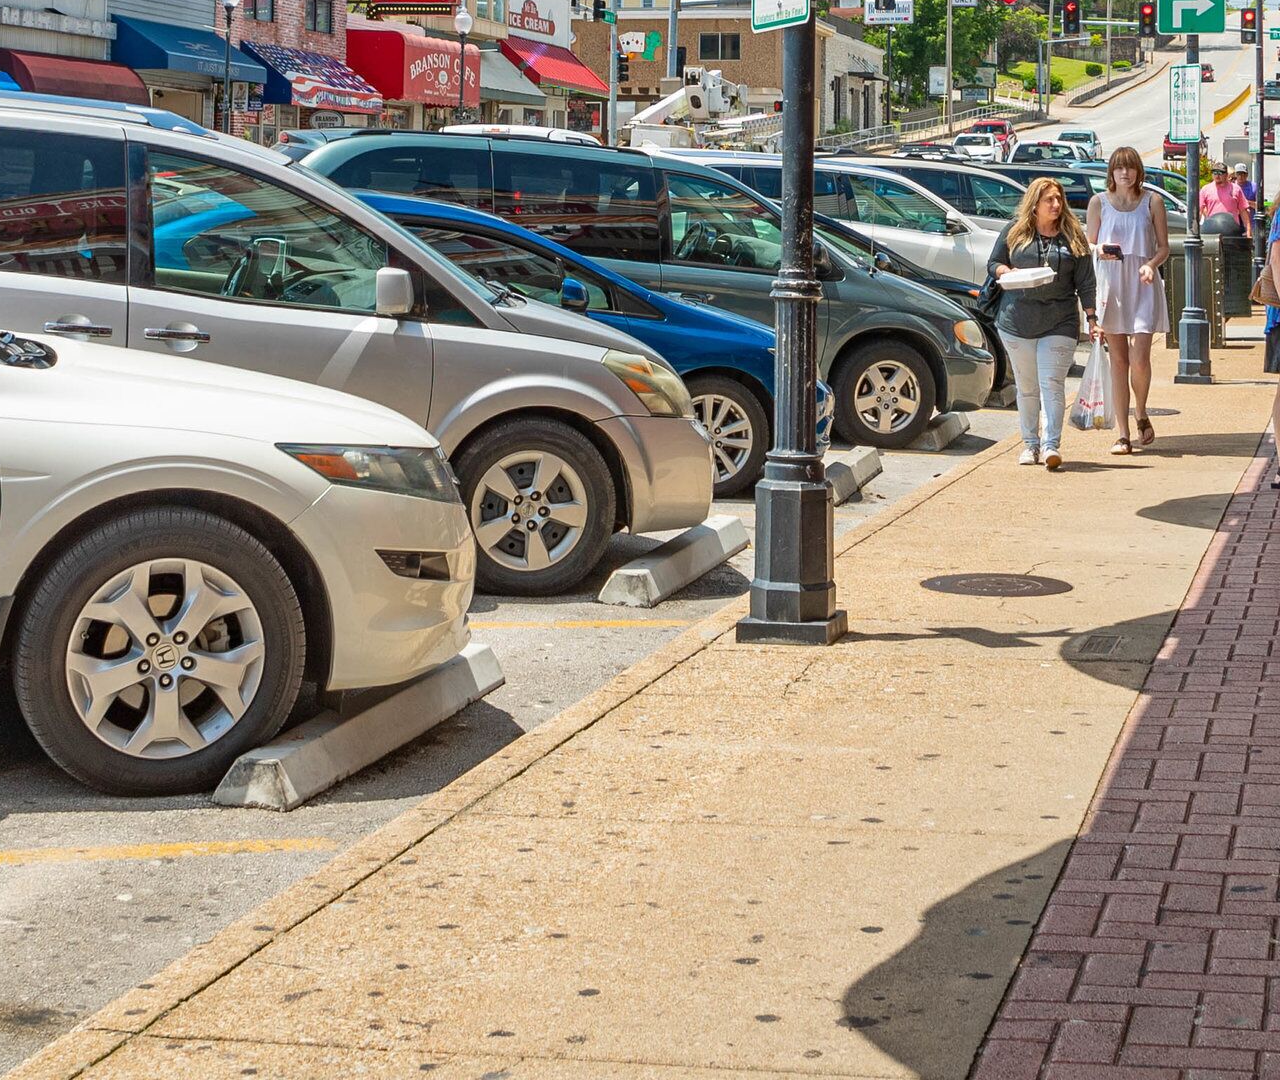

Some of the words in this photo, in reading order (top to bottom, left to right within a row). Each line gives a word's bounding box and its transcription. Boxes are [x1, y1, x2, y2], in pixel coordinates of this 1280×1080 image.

[509, 13, 522, 27] ICE
[524, 16, 550, 34] CREAM
[410, 53, 451, 80] BRANSON
[454, 58, 476, 88] CFE
[1173, 71, 1180, 88] 2
